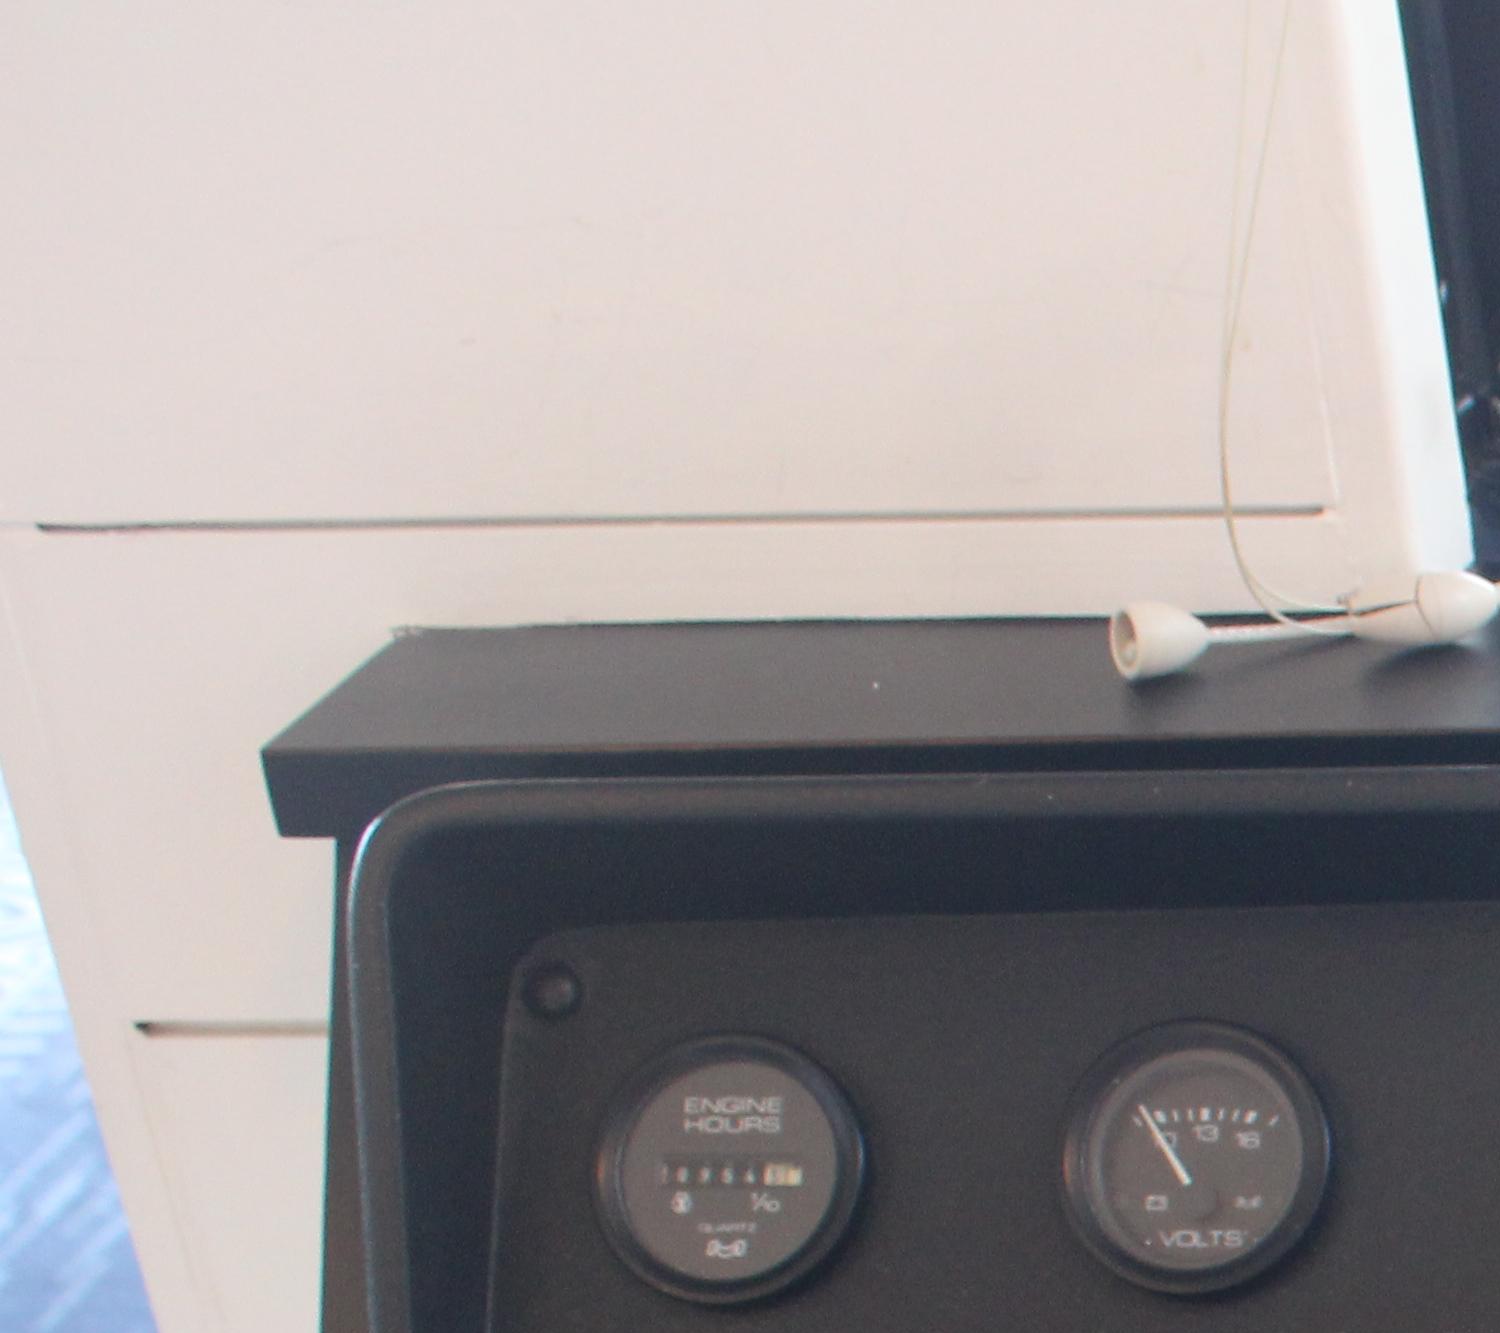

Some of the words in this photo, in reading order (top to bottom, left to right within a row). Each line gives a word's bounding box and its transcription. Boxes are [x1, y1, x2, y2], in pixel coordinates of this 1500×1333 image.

[684, 1096, 783, 1115] ENGINE
[684, 1116, 782, 1134] HOURS
[1193, 1124, 1219, 1142] 13
[1236, 1131, 1260, 1149] 16
[1158, 1230, 1243, 1248] VOLTS
